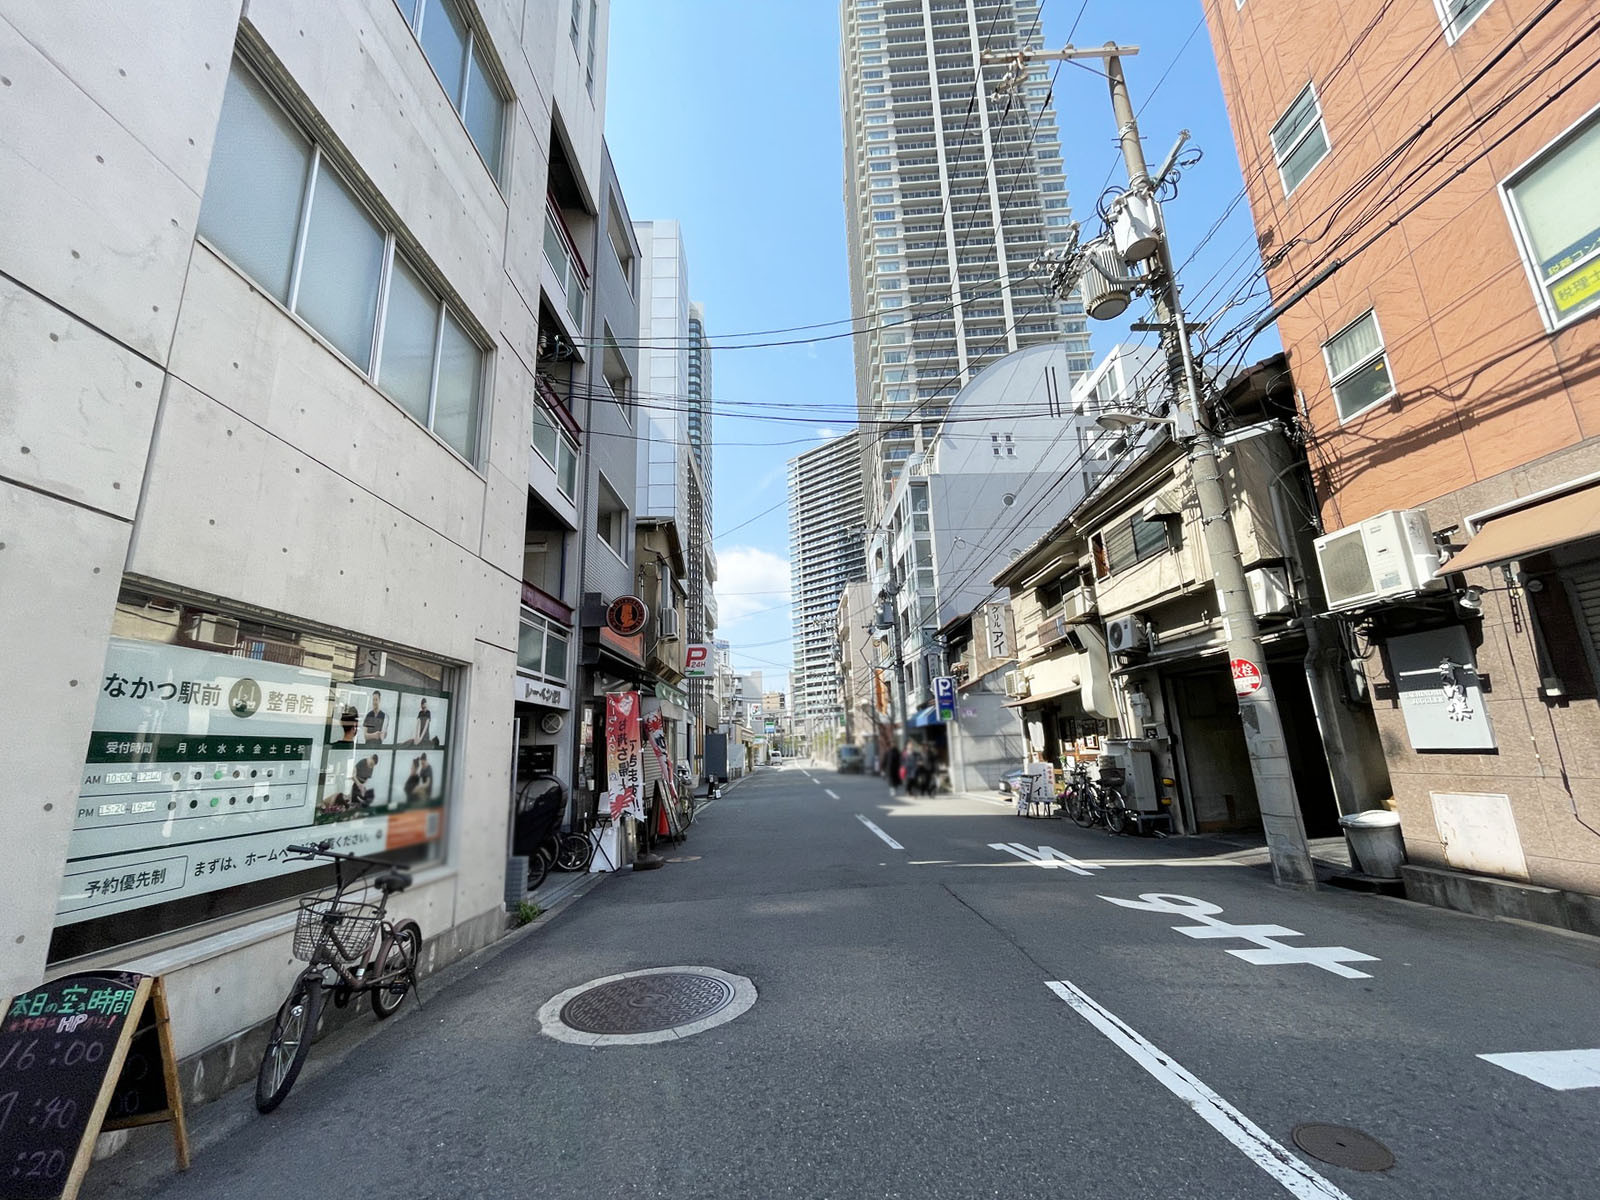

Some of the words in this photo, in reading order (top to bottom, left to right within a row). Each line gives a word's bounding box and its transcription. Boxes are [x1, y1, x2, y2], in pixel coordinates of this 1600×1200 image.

[103, 672, 222, 707] なかつ駅前
[266, 690, 314, 714] 整骨院
[105, 741, 153, 755] 受付時間
[177, 743, 187, 754] 月
[198, 743, 208, 754] 火
[217, 743, 227, 754] 水
[235, 743, 245, 754] 木
[253, 744, 262, 754] 金
[269, 744, 277, 754] 土
[85, 775, 101, 785] AM
[78, 809, 94, 818] PM
[84, 867, 168, 898] 予約優先制
[9, 984, 136, 1017] 本日の空き時間
